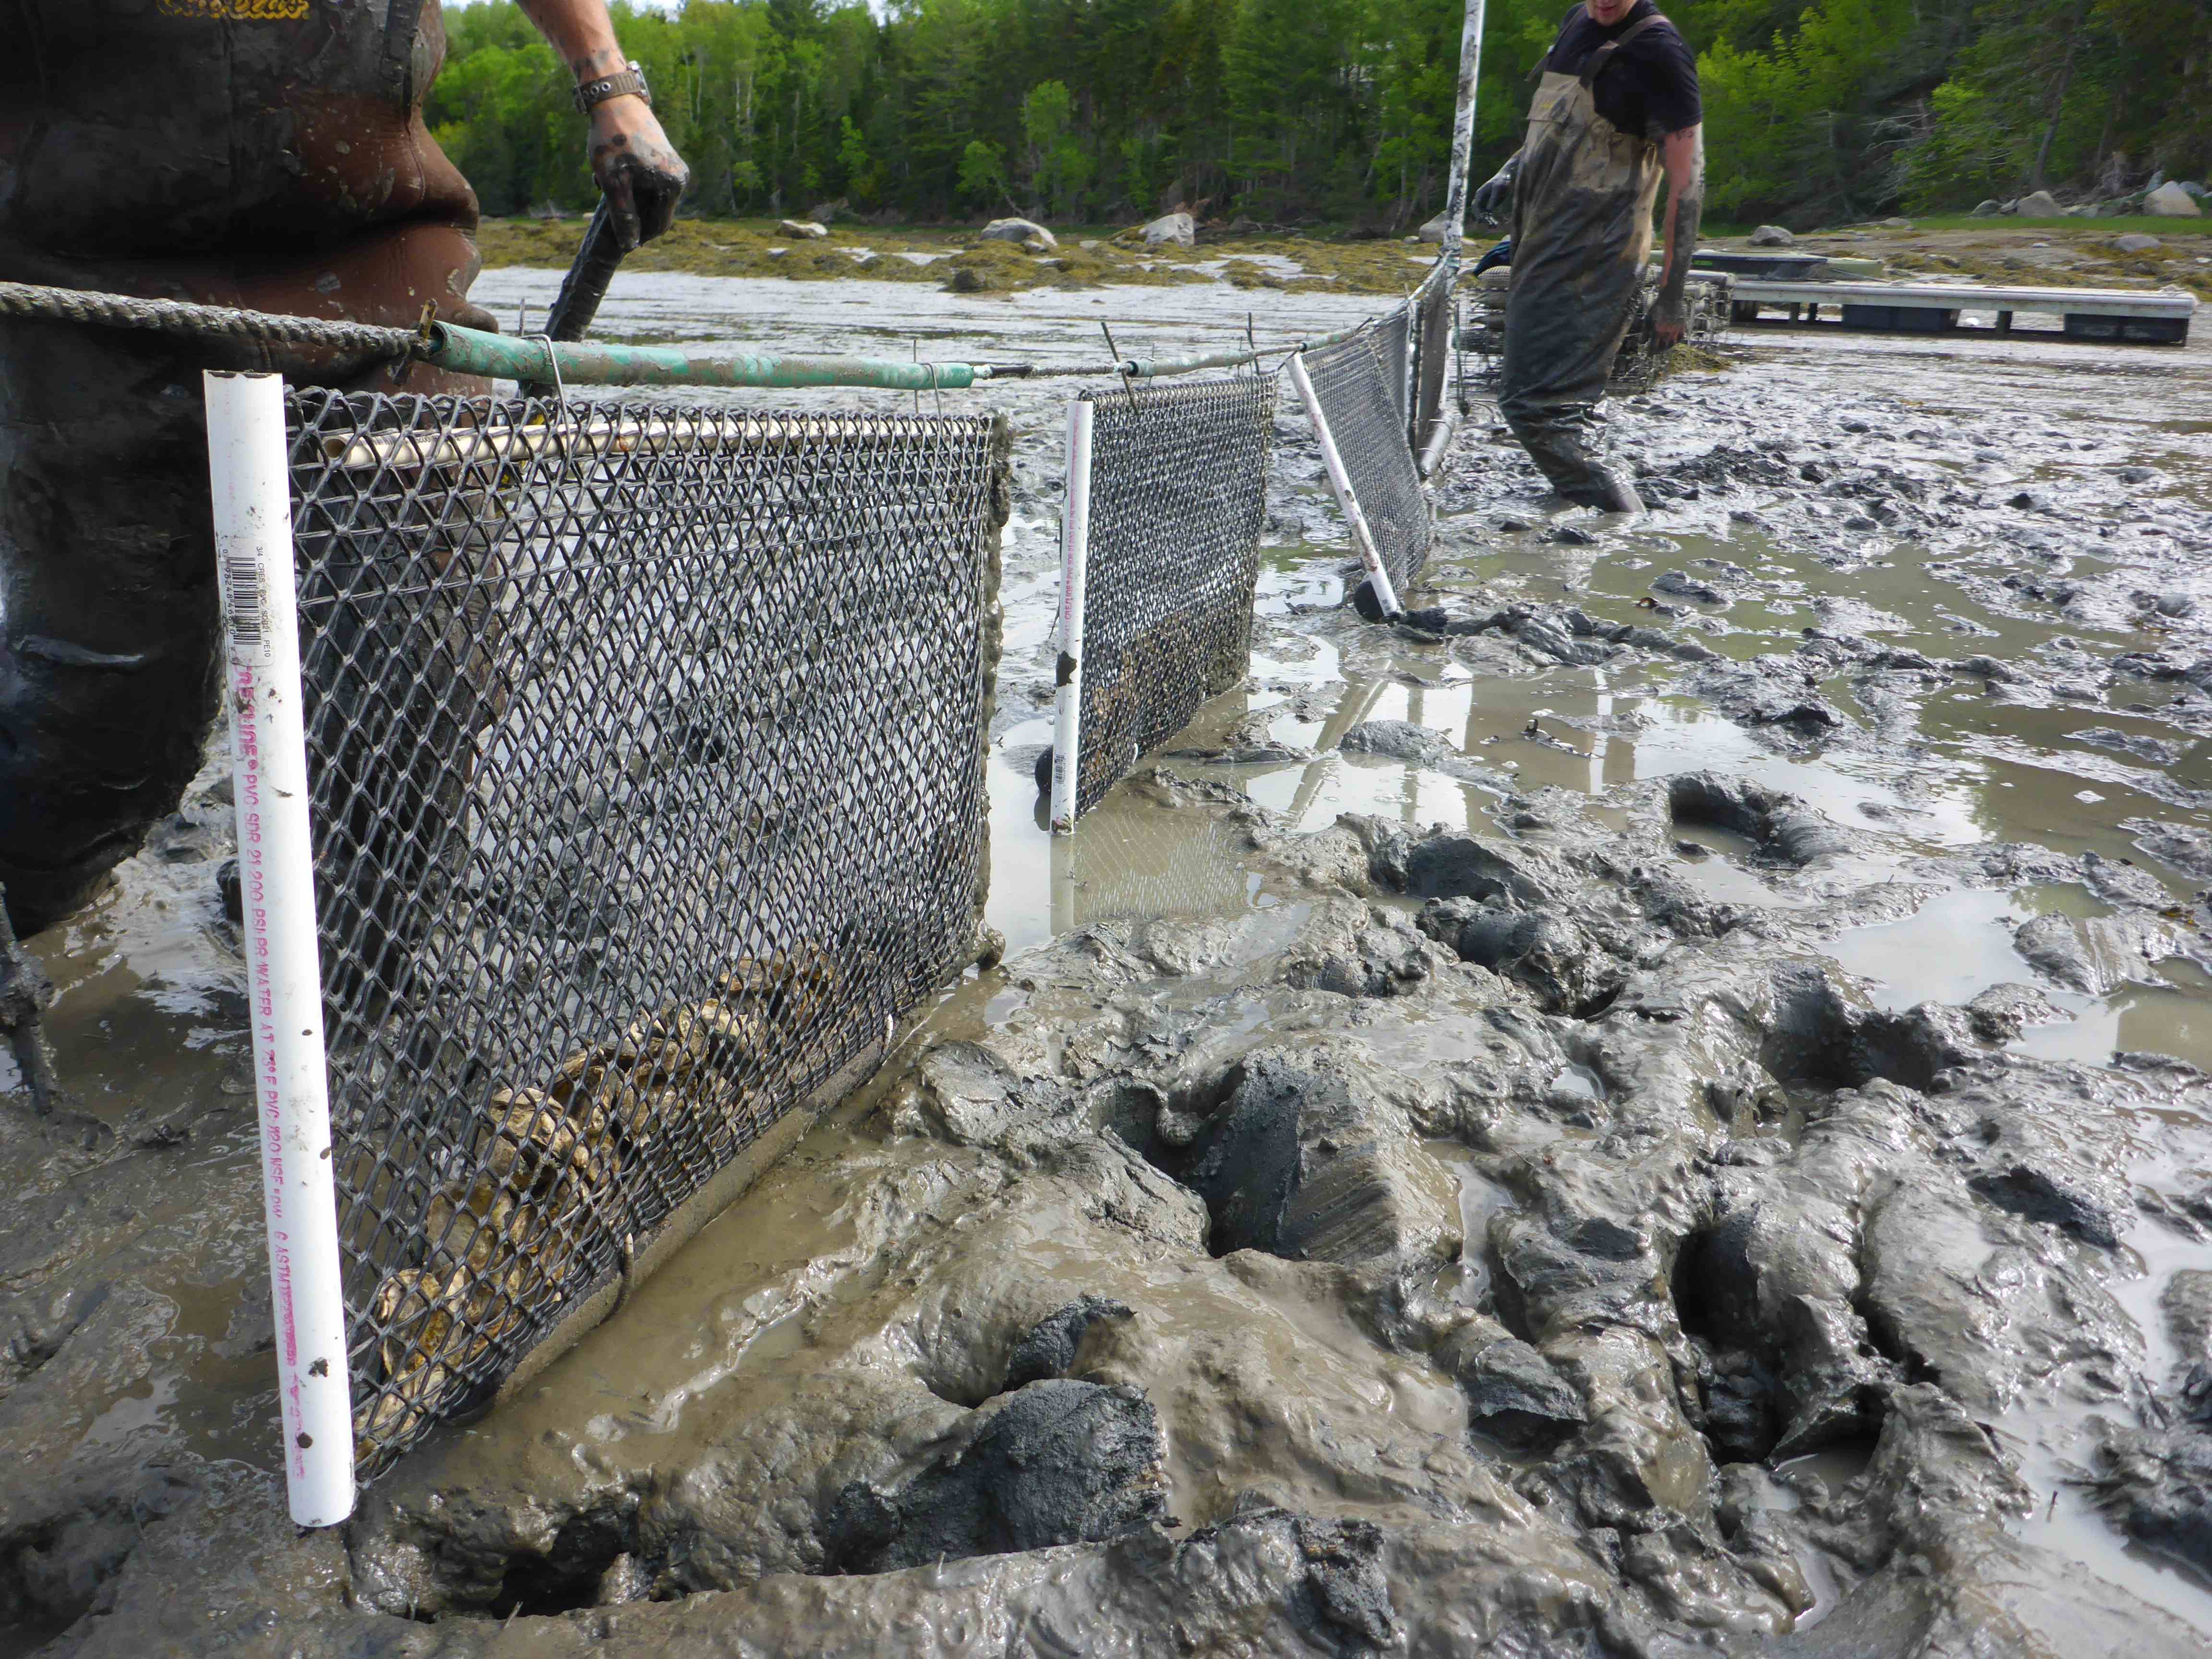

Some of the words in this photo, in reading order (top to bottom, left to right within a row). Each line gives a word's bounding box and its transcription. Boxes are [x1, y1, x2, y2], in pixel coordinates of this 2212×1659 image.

[242, 774, 260, 806] PVC
[245, 813, 262, 843] SDR
[247, 849, 262, 866] 21
[248, 870, 264, 902] 200
[252, 908, 266, 934] PSI
[253, 937, 269, 958] PR
[255, 961, 273, 1017] WATER
[261, 1022, 275, 1043] AT
[264, 1090, 280, 1122] PVC
[269, 1157, 284, 1186] NSF
[275, 1244, 290, 1284] ASTM
